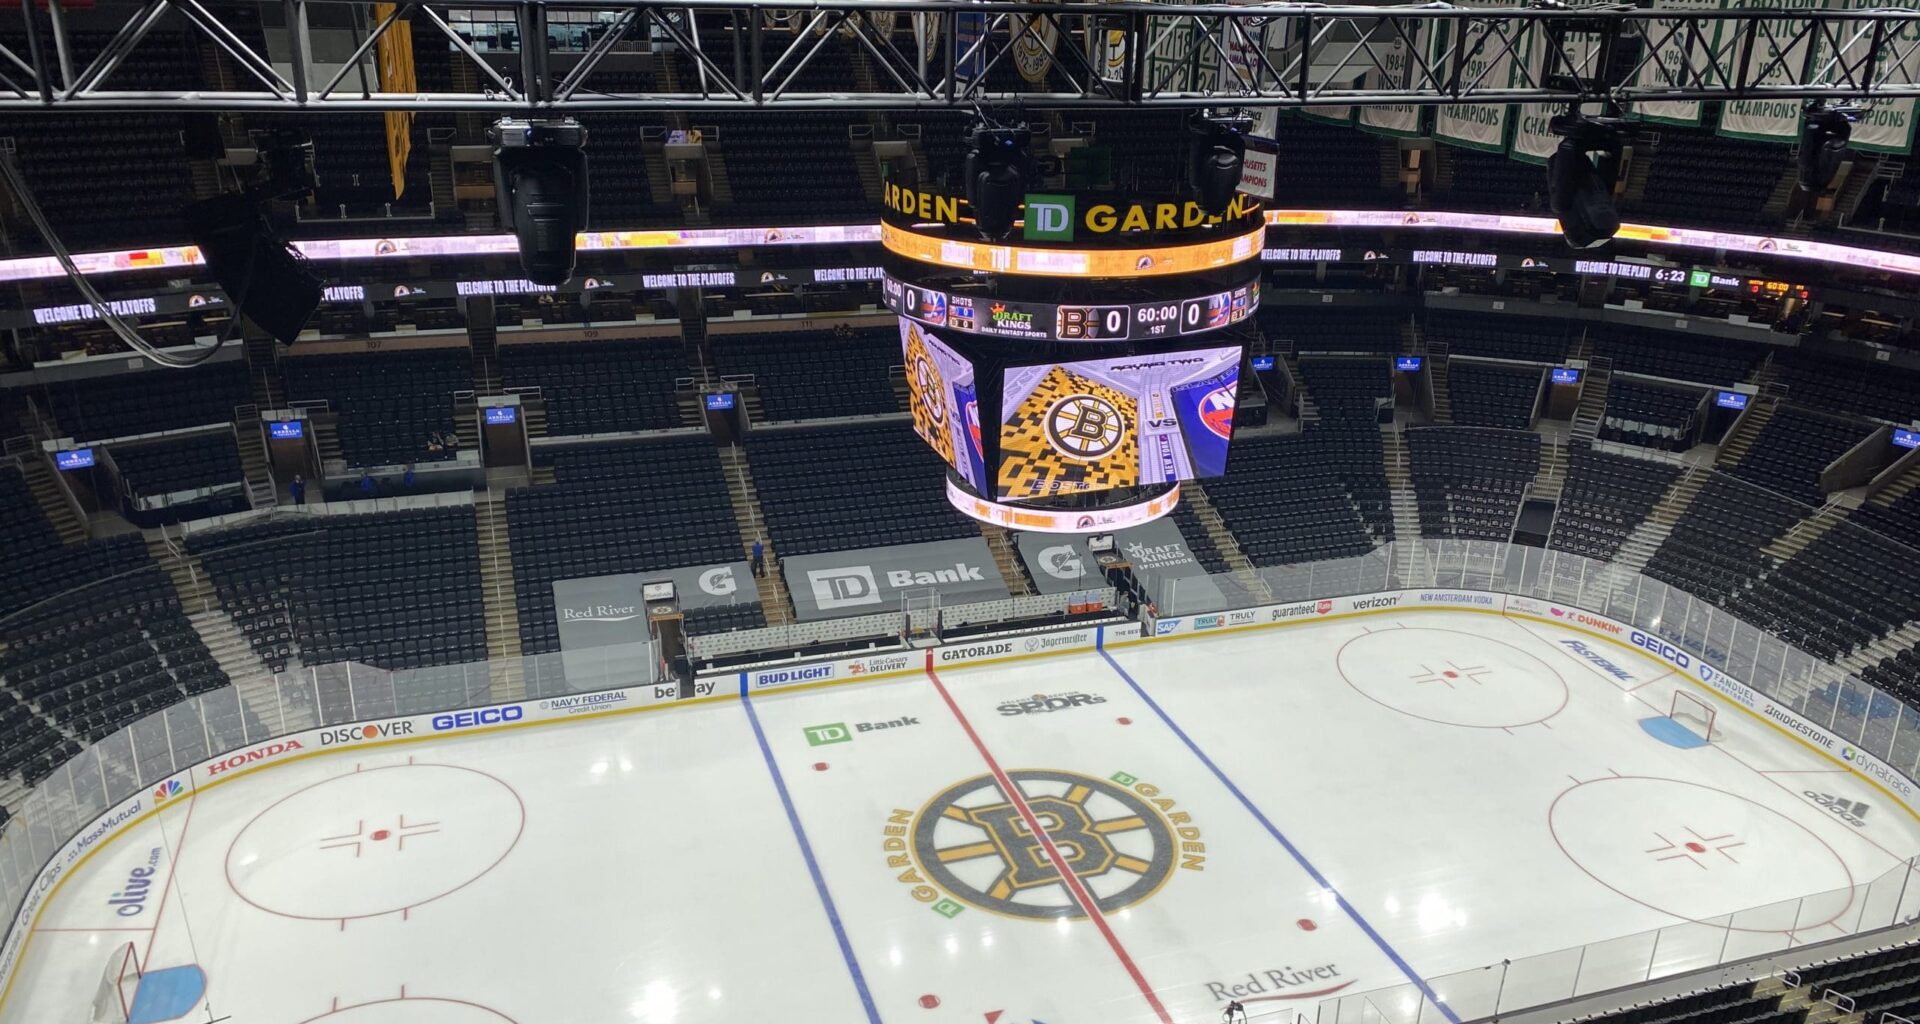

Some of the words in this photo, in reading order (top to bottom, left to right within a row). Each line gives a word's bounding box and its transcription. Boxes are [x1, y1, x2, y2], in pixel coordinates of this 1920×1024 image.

[1730, 100, 1796, 119] CHAMPIONS
[883, 184, 958, 223] ARDEN
[1029, 203, 1070, 232] TD
[1085, 194, 1245, 233] GARDN
[1465, 253, 1497, 266] PLAYOFFS
[702, 272, 735, 286] PLAYOFFS
[1655, 269, 1686, 282] 6:23
[1712, 275, 1740, 286] Bank
[324, 286, 365, 301] PLAYOFFS
[906, 289, 915, 311] 0
[952, 296, 973, 306] SHOTS
[33, 304, 79, 324] WELCOME
[80, 304, 93, 319] TO
[112, 298, 156, 316] PLAYOFFS
[992, 310, 1033, 322] DRAFT
[1137, 305, 1177, 323] 60:00
[1188, 303, 1200, 325] 0
[997, 319, 1032, 330] KINGS
[1106, 310, 1121, 332] 0
[1150, 324, 1166, 334] 1ST
[584, 330, 598, 338] 109
[981, 326, 997, 334] DAILY
[998, 327, 1023, 337] FANTASY
[1024, 330, 1047, 338] SPORTS
[1148, 418, 1177, 428] VS
[1131, 543, 1181, 558] DRAFT
[1141, 552, 1186, 563] KINGS
[1138, 558, 1194, 571] SPORTSBOOK
[816, 574, 871, 601] TD
[887, 563, 985, 588] Bank
[1353, 596, 1397, 610] verizon
[1420, 593, 1434, 602] NEW
[1434, 594, 1473, 604] AMSTERDAM
[1474, 596, 1493, 605] VODKA
[564, 607, 592, 620] Red
[596, 604, 635, 617] River
[1198, 615, 1217, 625] TRULY
[1229, 611, 1256, 620] TRULY
[1272, 602, 1316, 621] guaranteed
[1317, 602, 1332, 611] Rate
[1157, 622, 1176, 634] SAP
[942, 643, 1012, 660] GATORADE
[1630, 630, 1690, 669] GEICO
[870, 662, 907, 673] DELIVERY
[1558, 638, 1634, 682] FASTENAL
[759, 672, 790, 685] BUD
[791, 666, 832, 681] LIGHT
[1714, 672, 1756, 702] FANDUEL
[551, 695, 580, 709] NAVY
[582, 691, 626, 704] FEDERAL
[568, 706, 590, 715] Credit
[592, 703, 612, 712] Union
[432, 706, 523, 732] GEICO
[1763, 703, 1836, 749] BRIDGESTONE
[320, 720, 415, 746] DISCOVER
[808, 727, 845, 742] TD
[855, 716, 921, 734] Bank
[208, 738, 304, 776] HONDA
[1855, 752, 1911, 798] dynatrace
[1802, 789, 1867, 828] adidas
[76, 800, 142, 855] MassMutual
[1134, 782, 1206, 871] GARDEN
[883, 808, 939, 904] GARDEN
[1203, 972, 1268, 1001] Red
[1264, 962, 1341, 989] River
